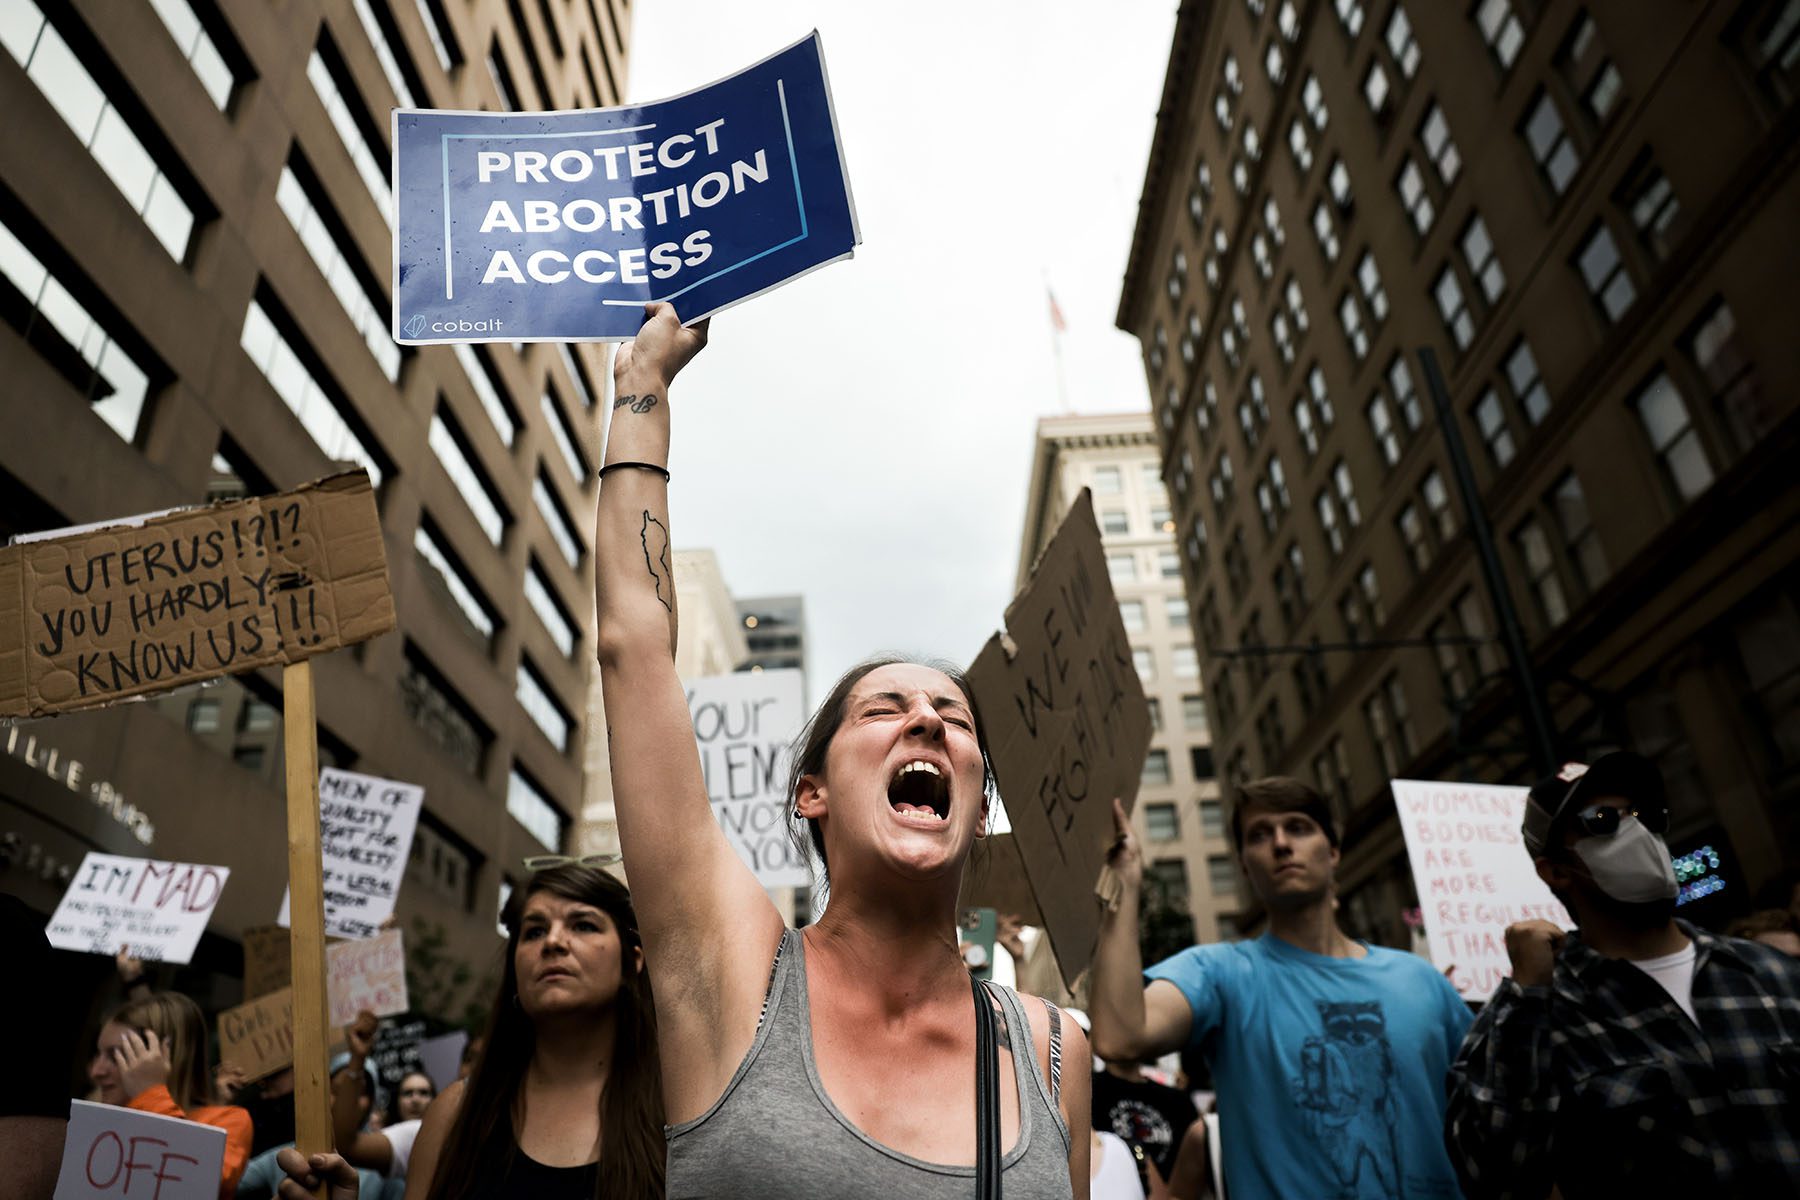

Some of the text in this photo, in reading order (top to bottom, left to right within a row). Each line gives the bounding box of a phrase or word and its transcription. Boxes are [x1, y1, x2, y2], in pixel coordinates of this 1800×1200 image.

[477, 117, 725, 184] PROTECT
[479, 149, 770, 233] ABORTION
[481, 229, 714, 284] ACCESS
[431, 317, 504, 334] cobalt
[65, 503, 302, 594] UTERUS!?!?
[39, 567, 273, 657] YOU HARDLY
[77, 631, 196, 695] KNOW
[1416, 819, 1519, 845] BODIES
[1424, 848, 1474, 870] ARE
[131, 860, 223, 914] MAD
[1430, 872, 1498, 897] MORE
[85, 1130, 199, 1200] OFF
